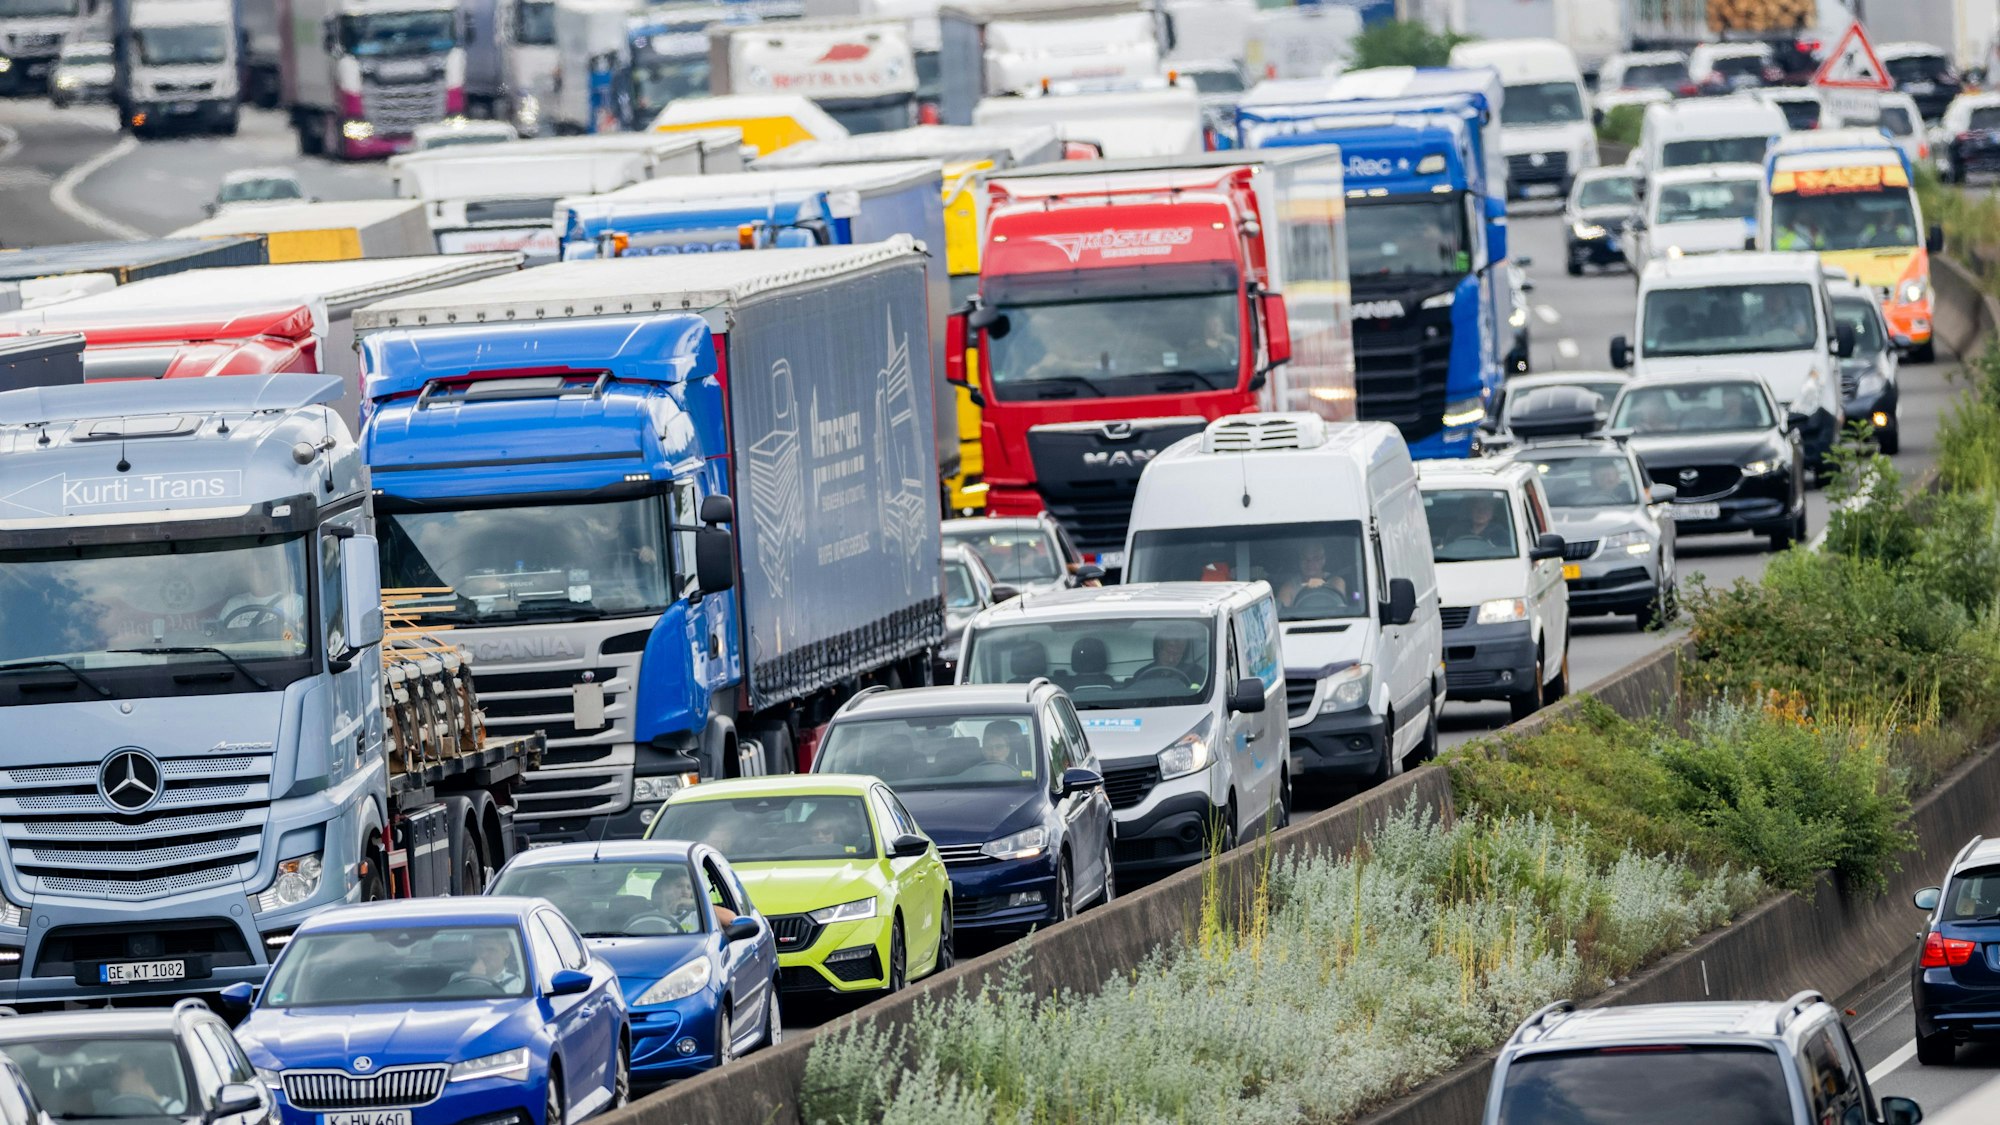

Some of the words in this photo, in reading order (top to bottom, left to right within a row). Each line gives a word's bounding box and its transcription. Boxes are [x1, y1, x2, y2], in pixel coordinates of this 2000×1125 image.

[1083, 449, 1157, 466] MAN
[108, 966, 124, 979] GE
[133, 964, 149, 978] KT
[152, 963, 183, 977] 1082
[330, 1115, 340, 1125] K
